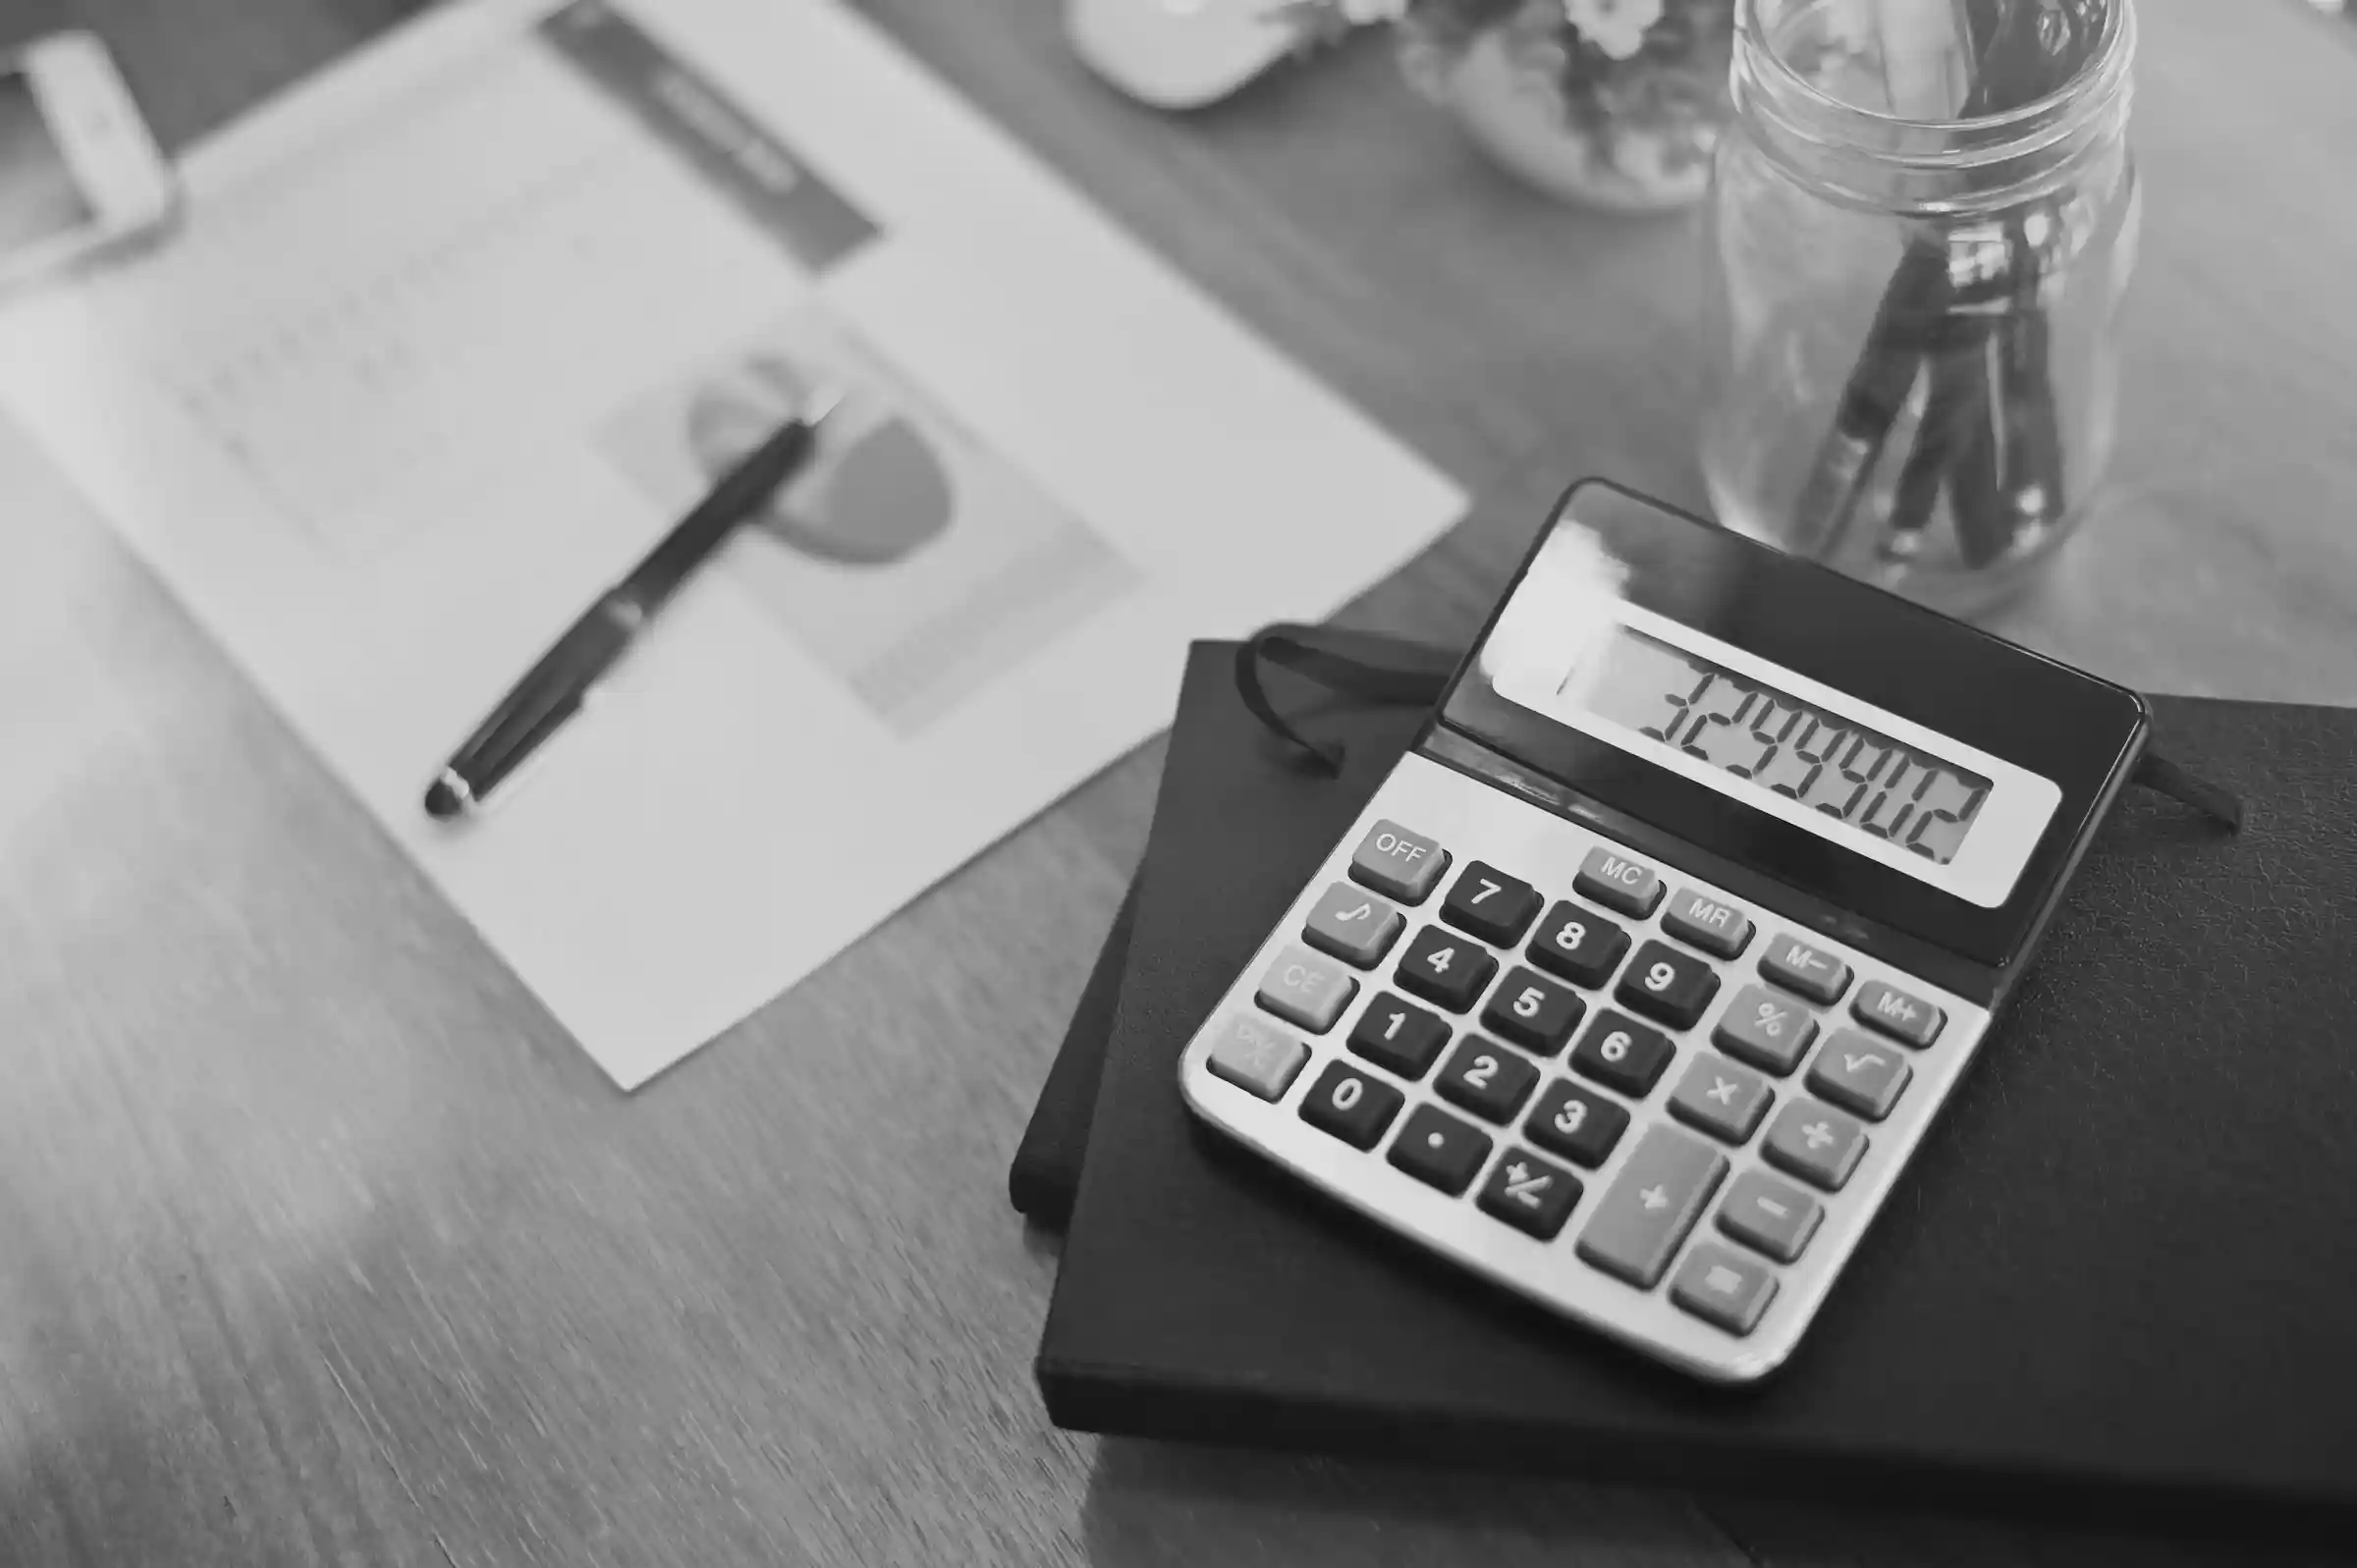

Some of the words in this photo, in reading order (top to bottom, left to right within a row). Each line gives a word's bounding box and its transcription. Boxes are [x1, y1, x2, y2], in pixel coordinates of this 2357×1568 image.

[1375, 833, 1427, 864] OFF
[1600, 855, 1643, 885] MC
[1471, 878, 1502, 904] 7
[1688, 897, 1730, 929] MR
[1556, 921, 1586, 950] 8
[1427, 946, 1455, 974] 4
[1644, 961, 1676, 992] 9
[1512, 986, 1545, 1018] 5
[1384, 1011, 1406, 1041] 1
[1754, 1001, 1788, 1038] %
[1600, 1031, 1633, 1062] 6
[1462, 1054, 1499, 1089] 2
[1332, 1077, 1364, 1111] 0
[1554, 1099, 1588, 1134] 3
